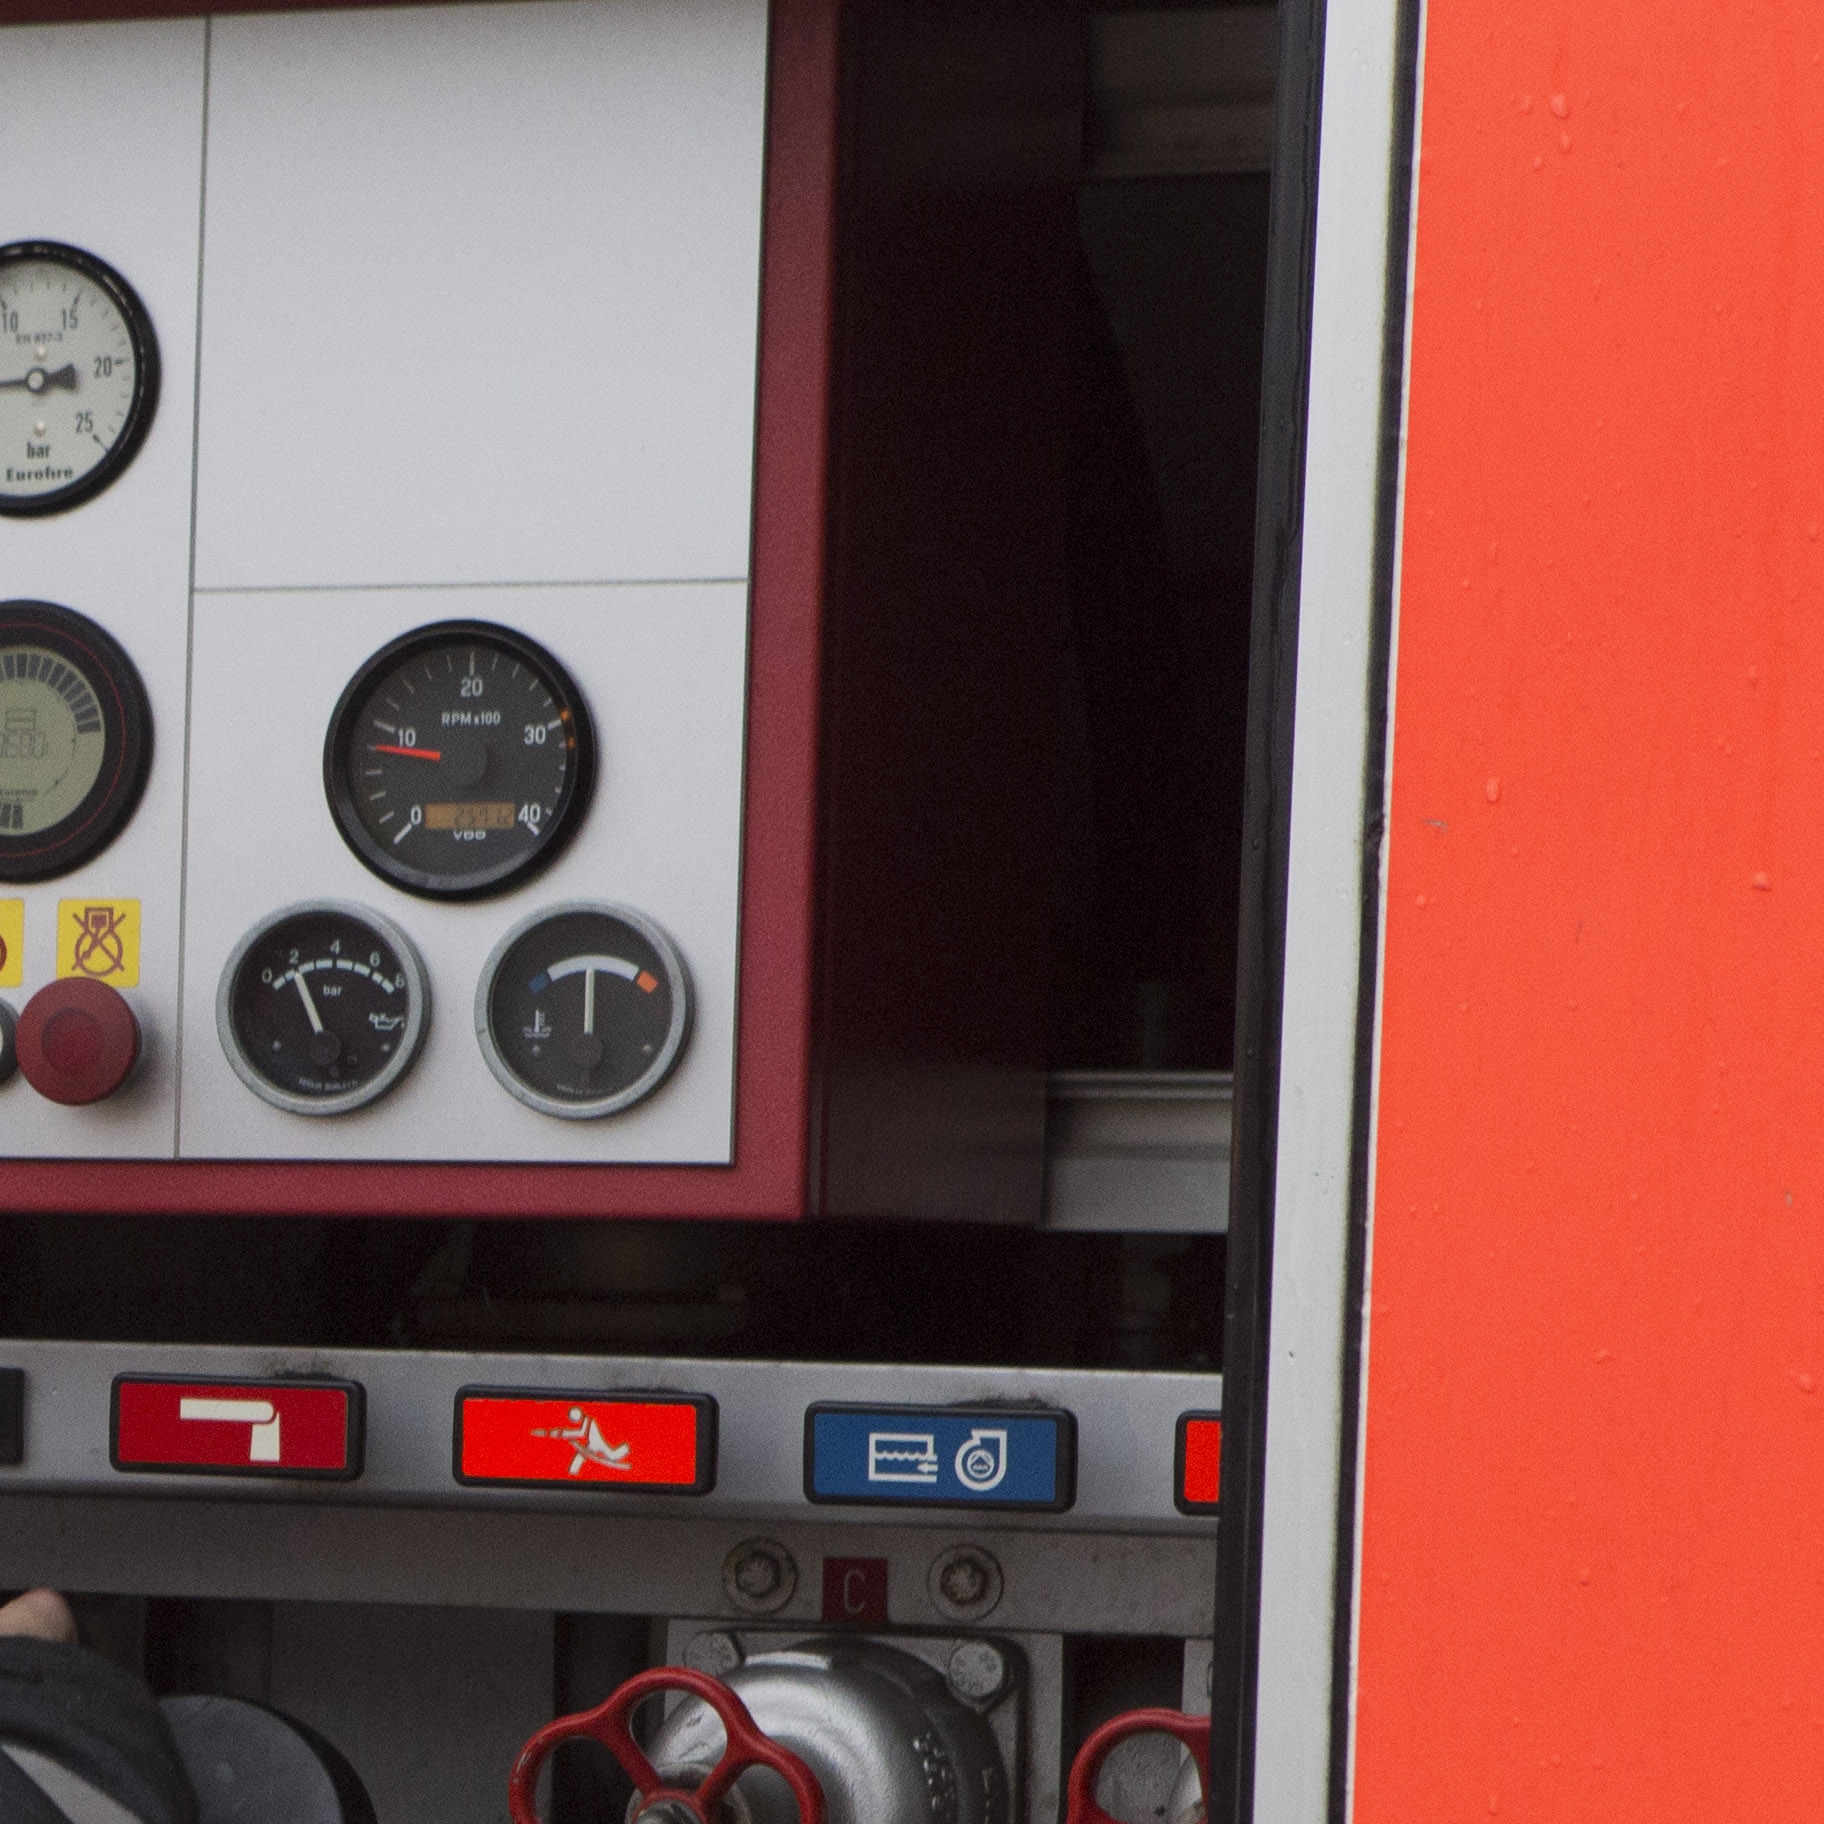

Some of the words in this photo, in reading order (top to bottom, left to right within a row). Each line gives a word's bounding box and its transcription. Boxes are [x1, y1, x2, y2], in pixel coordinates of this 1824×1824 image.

[2, 311, 19, 333] 10
[62, 308, 78, 330] 15
[94, 356, 113, 379] 20
[75, 412, 94, 434] 25
[27, 441, 52, 460] bar
[5, 467, 74, 483] Eurofire
[460, 678, 483, 698] 20
[398, 728, 417, 748] 10
[524, 725, 546, 746] 30
[410, 805, 422, 825] 0
[517, 803, 541, 823] 40
[453, 830, 487, 841] VDO
[289, 948, 300, 965] 2
[329, 938, 341, 956] 4
[261, 968, 273, 984] 0
[322, 984, 343, 997] bar
[843, 1567, 867, 1614] C
